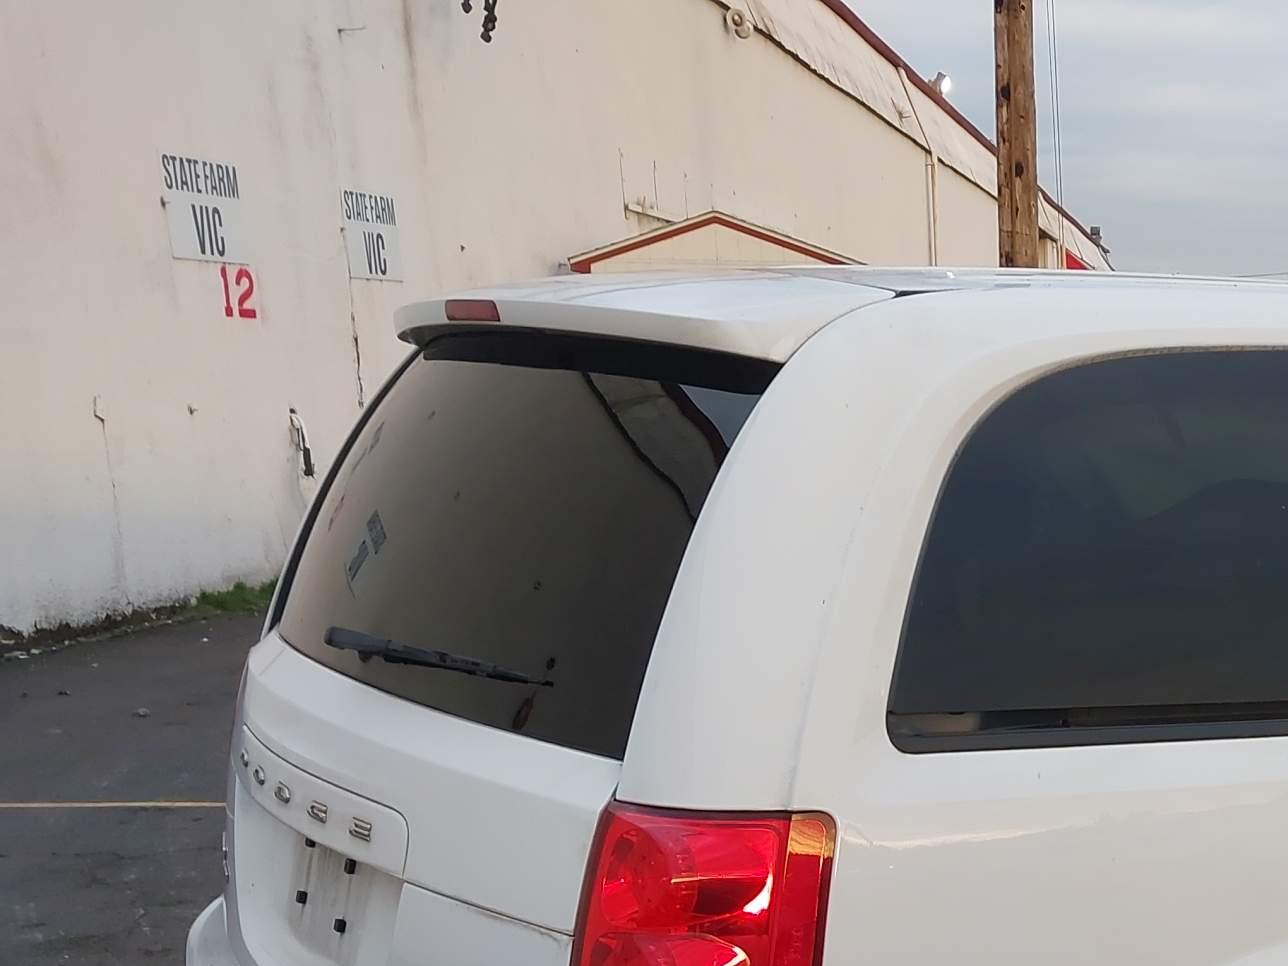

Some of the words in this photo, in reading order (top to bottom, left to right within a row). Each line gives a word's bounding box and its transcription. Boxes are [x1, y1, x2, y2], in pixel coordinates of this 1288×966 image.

[161, 153, 203, 194] STATE
[202, 160, 240, 200] FARM
[191, 203, 226, 257] VIC
[343, 189, 370, 223] STATE
[370, 193, 397, 226] FARM
[362, 231, 388, 276] VIC
[220, 264, 257, 319] 12
